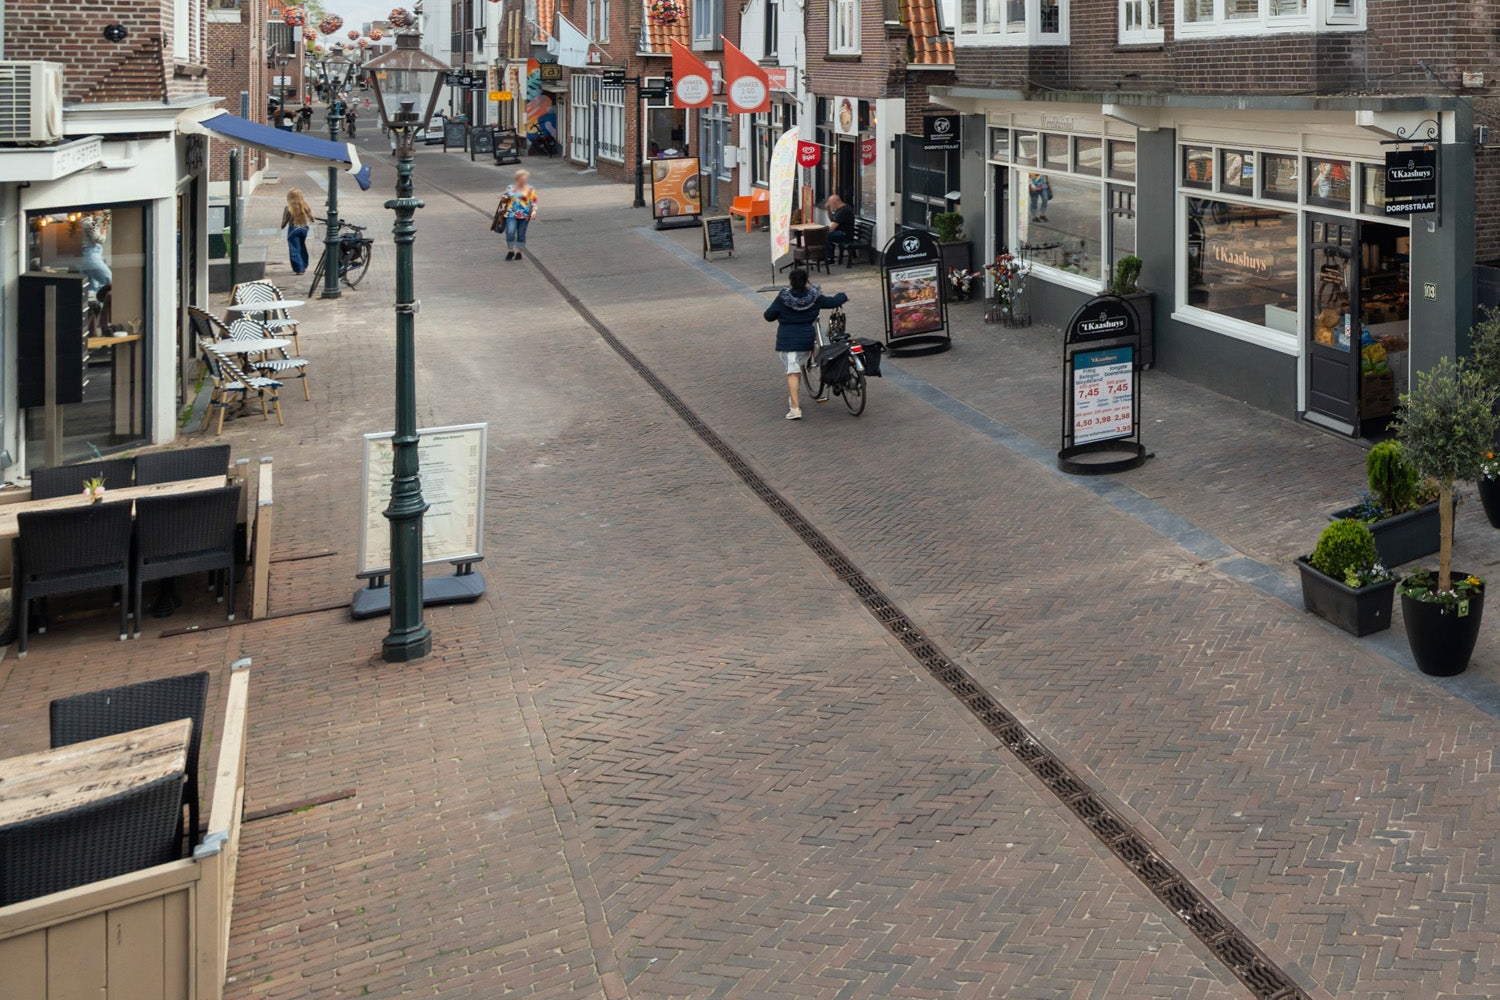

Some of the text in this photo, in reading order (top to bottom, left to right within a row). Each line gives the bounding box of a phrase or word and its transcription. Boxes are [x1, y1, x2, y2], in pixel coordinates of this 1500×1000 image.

[1398, 169, 1430, 178] Kaashuys
[1386, 202, 1435, 212] DORPSSTRAAT
[1220, 246, 1267, 273] Kaashuys
[1424, 284, 1435, 299] 103
[1088, 319, 1124, 330] Kaashuys
[1078, 388, 1100, 399] 7,45
[1108, 383, 1129, 394] 7,45
[1095, 415, 1112, 425] 3,98
[1114, 412, 1130, 422] 2,98
[1075, 418, 1093, 428] 4,50
[1116, 425, 1132, 434] 3,95
